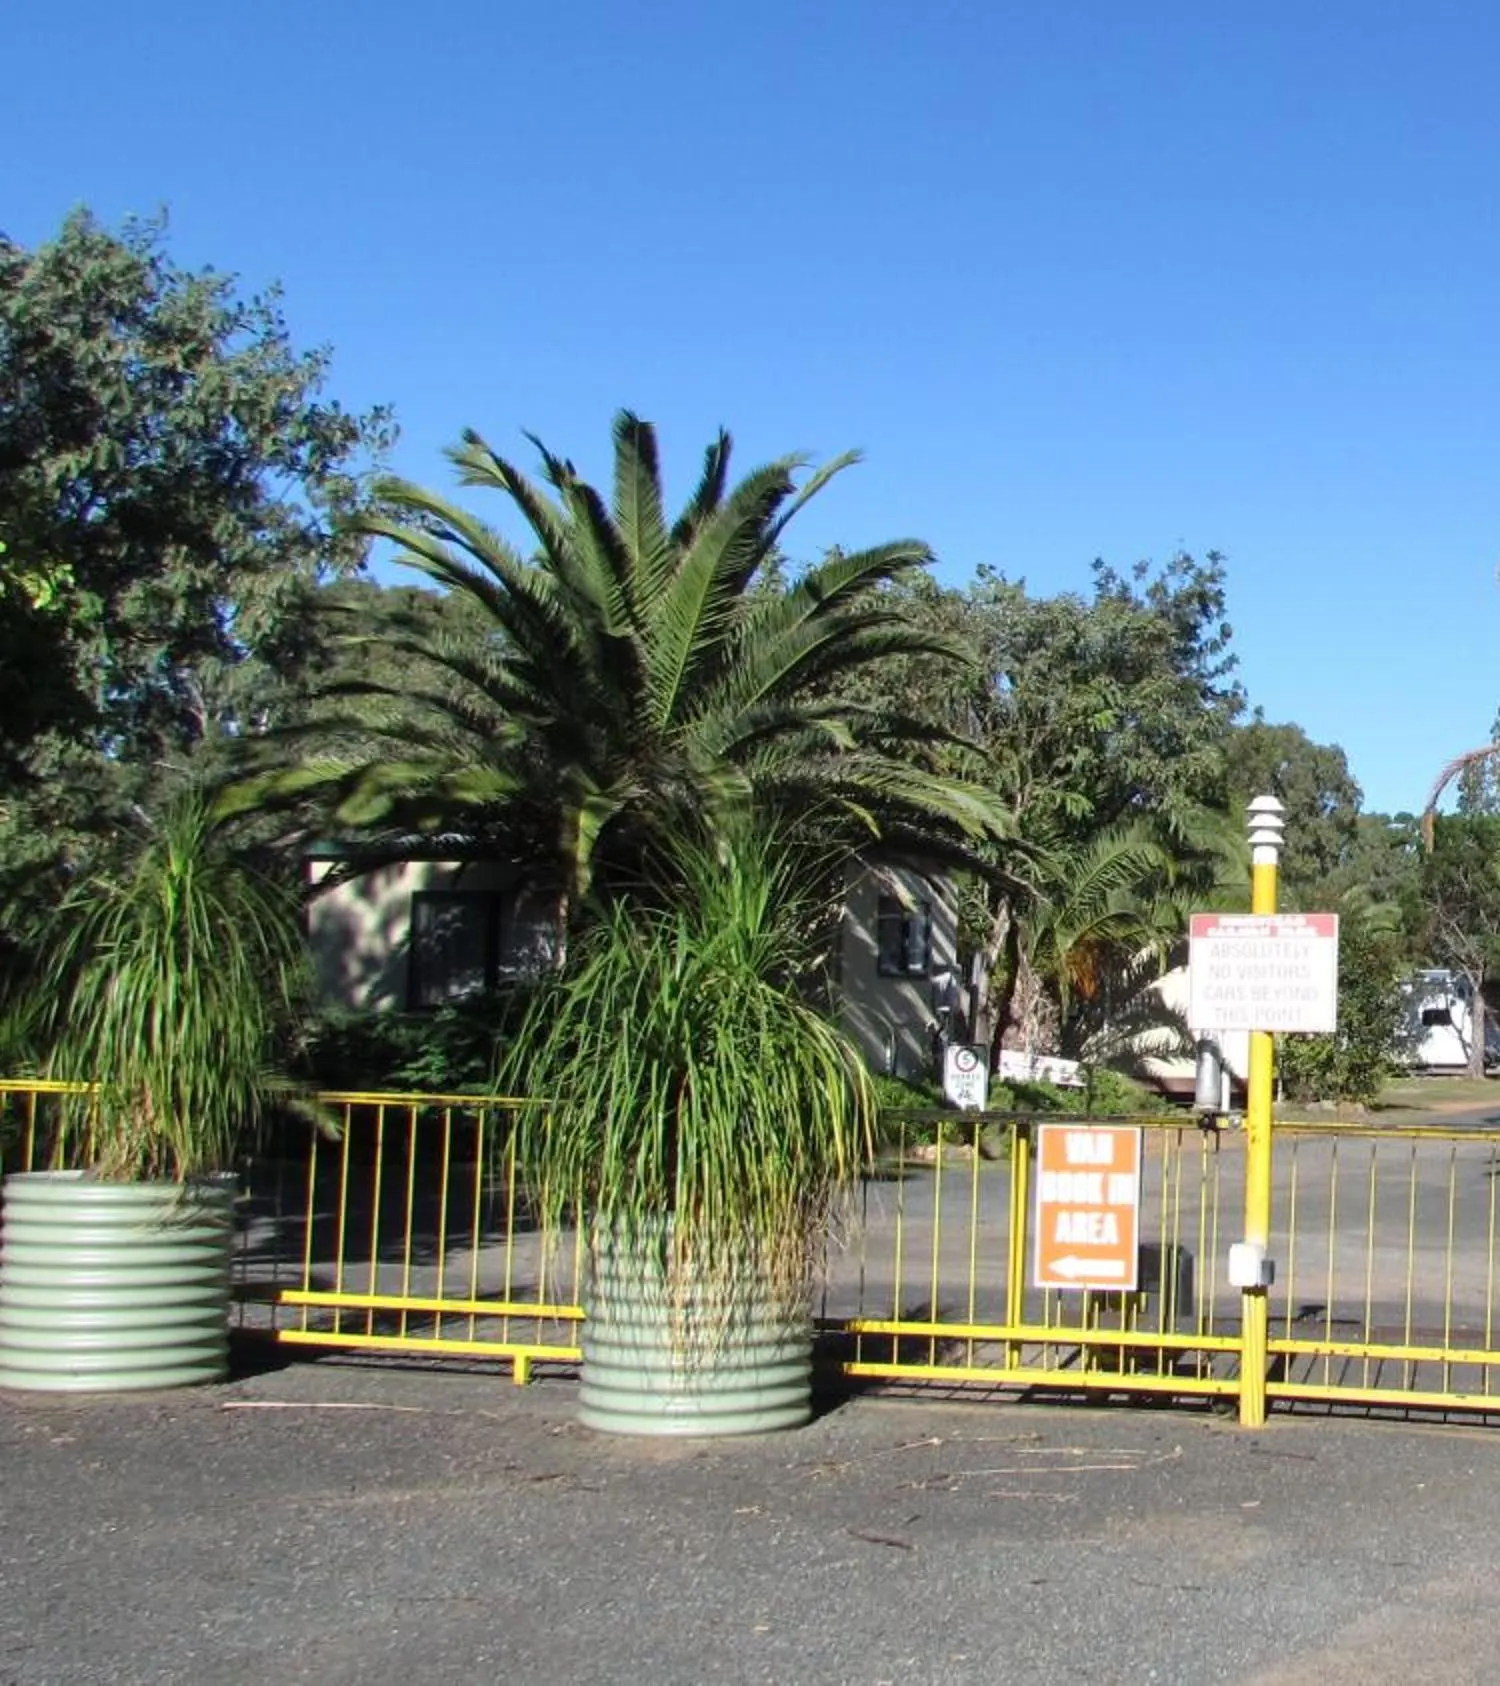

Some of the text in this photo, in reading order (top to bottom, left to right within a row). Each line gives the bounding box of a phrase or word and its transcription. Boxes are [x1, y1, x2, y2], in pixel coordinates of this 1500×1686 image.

[1210, 941, 1311, 959] ABSOLUTELY
[1208, 963, 1311, 980] NO VISITORS
[1203, 984, 1319, 1001] CARS BEYOND
[1214, 1006, 1302, 1024] THIS POINT
[1054, 1210, 1119, 1246] AREA
